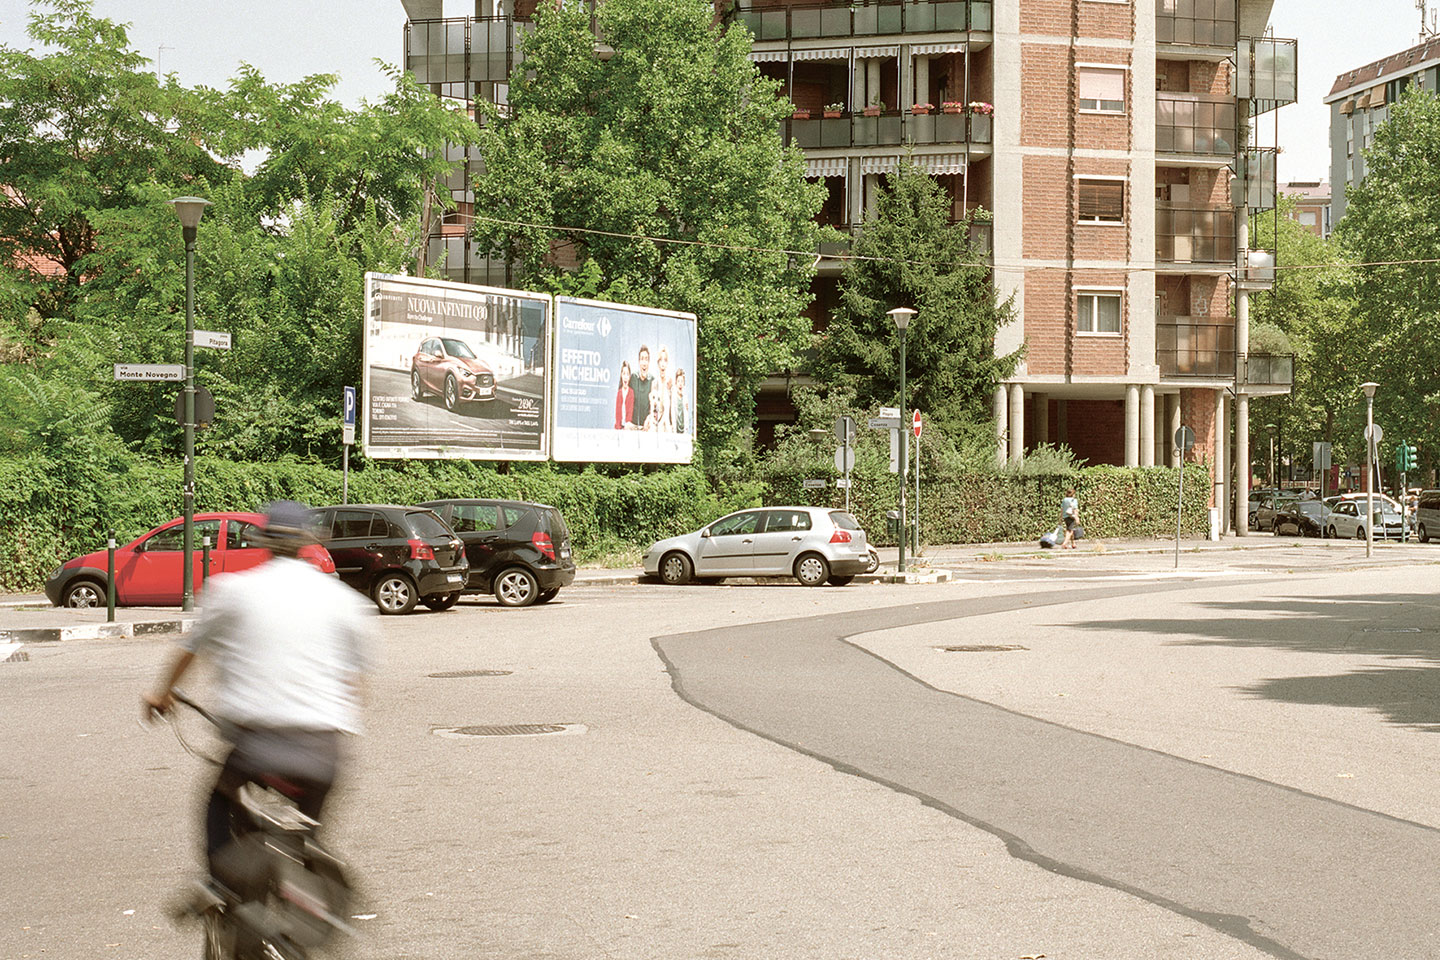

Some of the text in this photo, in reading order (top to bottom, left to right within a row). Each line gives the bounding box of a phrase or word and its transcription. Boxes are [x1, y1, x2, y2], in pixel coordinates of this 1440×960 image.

[408, 297, 437, 315] NUOVA
[437, 300, 473, 319] INFINITI
[562, 316, 595, 331] Carrefour
[561, 348, 601, 366] EFFETTO
[146, 371, 178, 379] Novegno
[561, 365, 611, 383] NICHELINO
[346, 390, 354, 421] P
